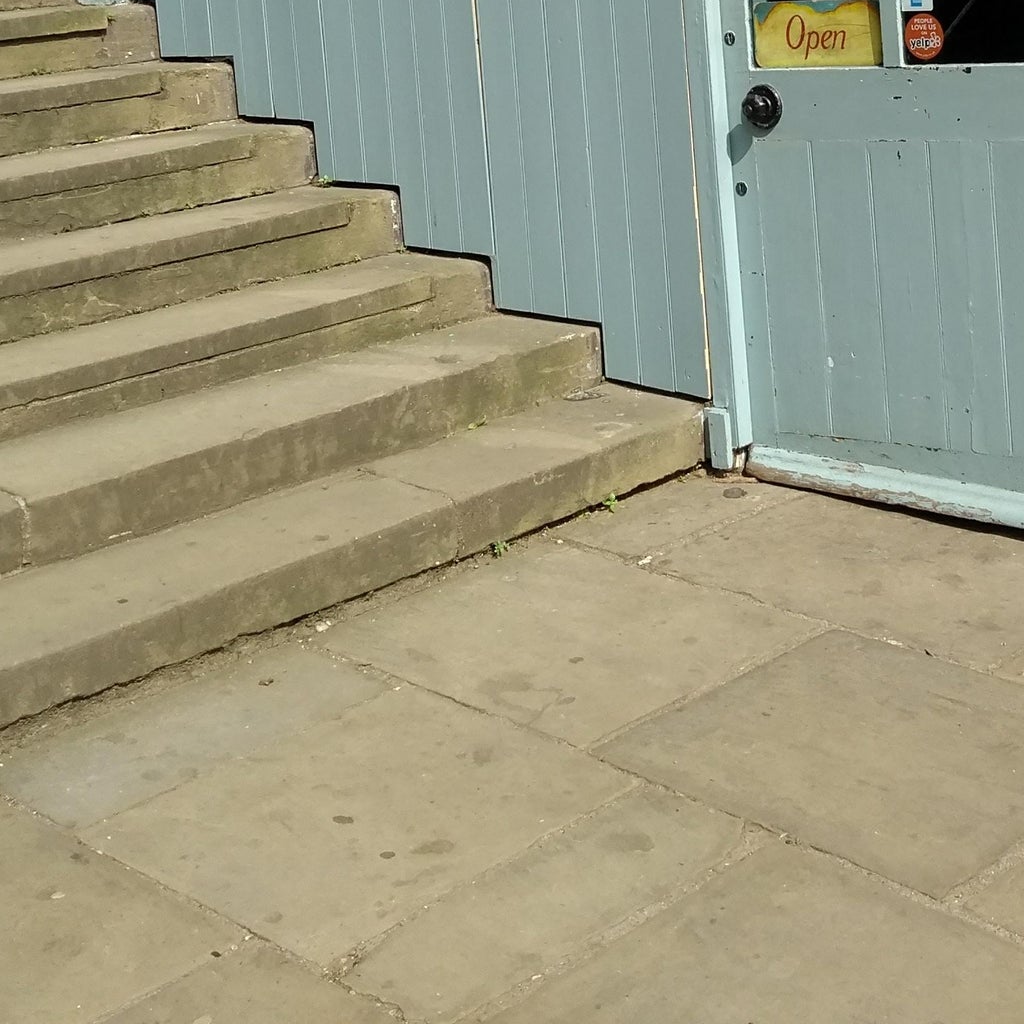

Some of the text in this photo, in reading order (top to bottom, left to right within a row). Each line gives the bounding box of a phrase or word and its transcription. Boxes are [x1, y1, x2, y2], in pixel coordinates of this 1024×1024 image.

[928, 23, 936, 31] US
[786, 14, 846, 60] Open
[910, 37, 931, 50] yelp
